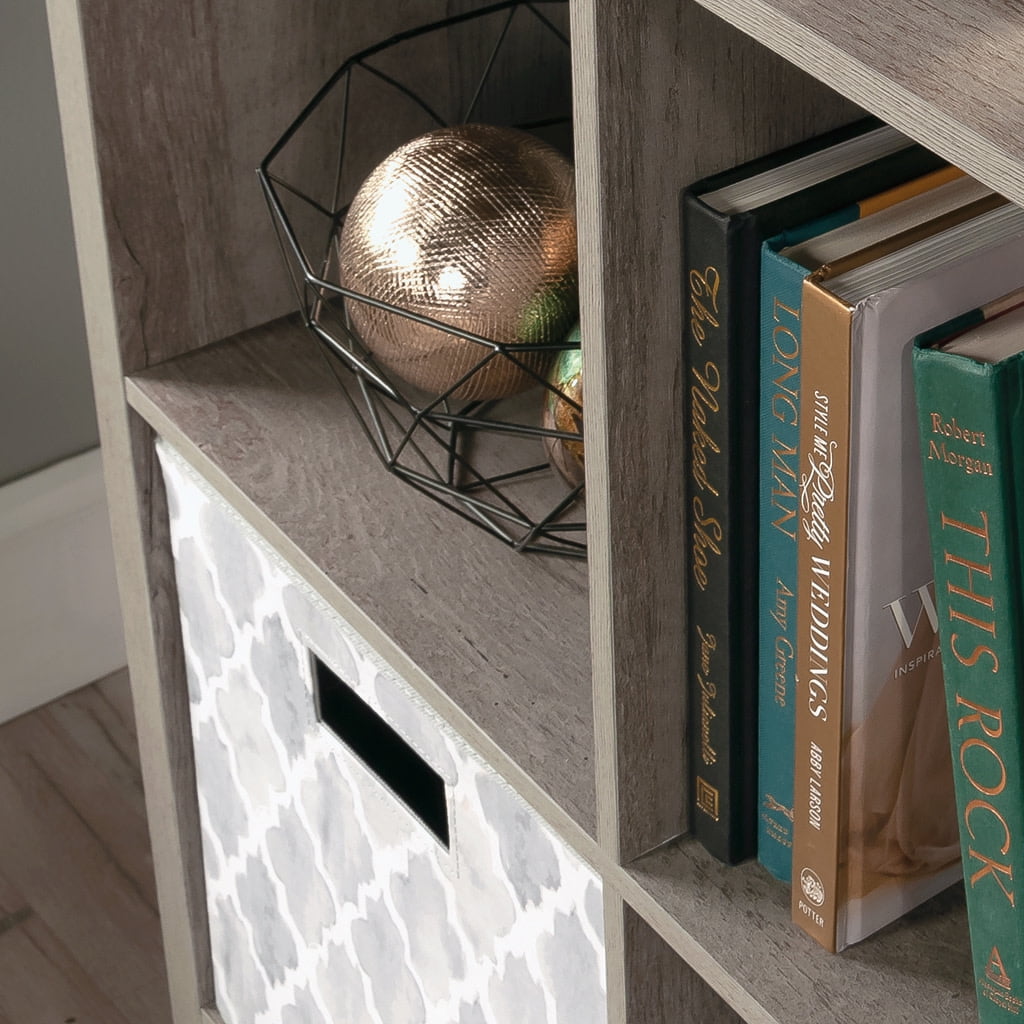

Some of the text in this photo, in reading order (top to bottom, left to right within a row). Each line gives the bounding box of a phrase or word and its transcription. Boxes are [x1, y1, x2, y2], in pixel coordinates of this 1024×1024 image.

[690, 265, 720, 346] The
[691, 361, 720, 497] Naked
[927, 440, 994, 476] Morgan
[929, 412, 986, 447] Robert
[693, 496, 722, 592] Shoe
[769, 296, 800, 708] LONG MAN Amy Greene
[799, 390, 838, 831] STYLE ME Pretty WEDDINGS ABBY LARSON
[941, 510, 1000, 674] THIS
[955, 693, 1017, 908] ROCK
[799, 899, 825, 928] POTTER
